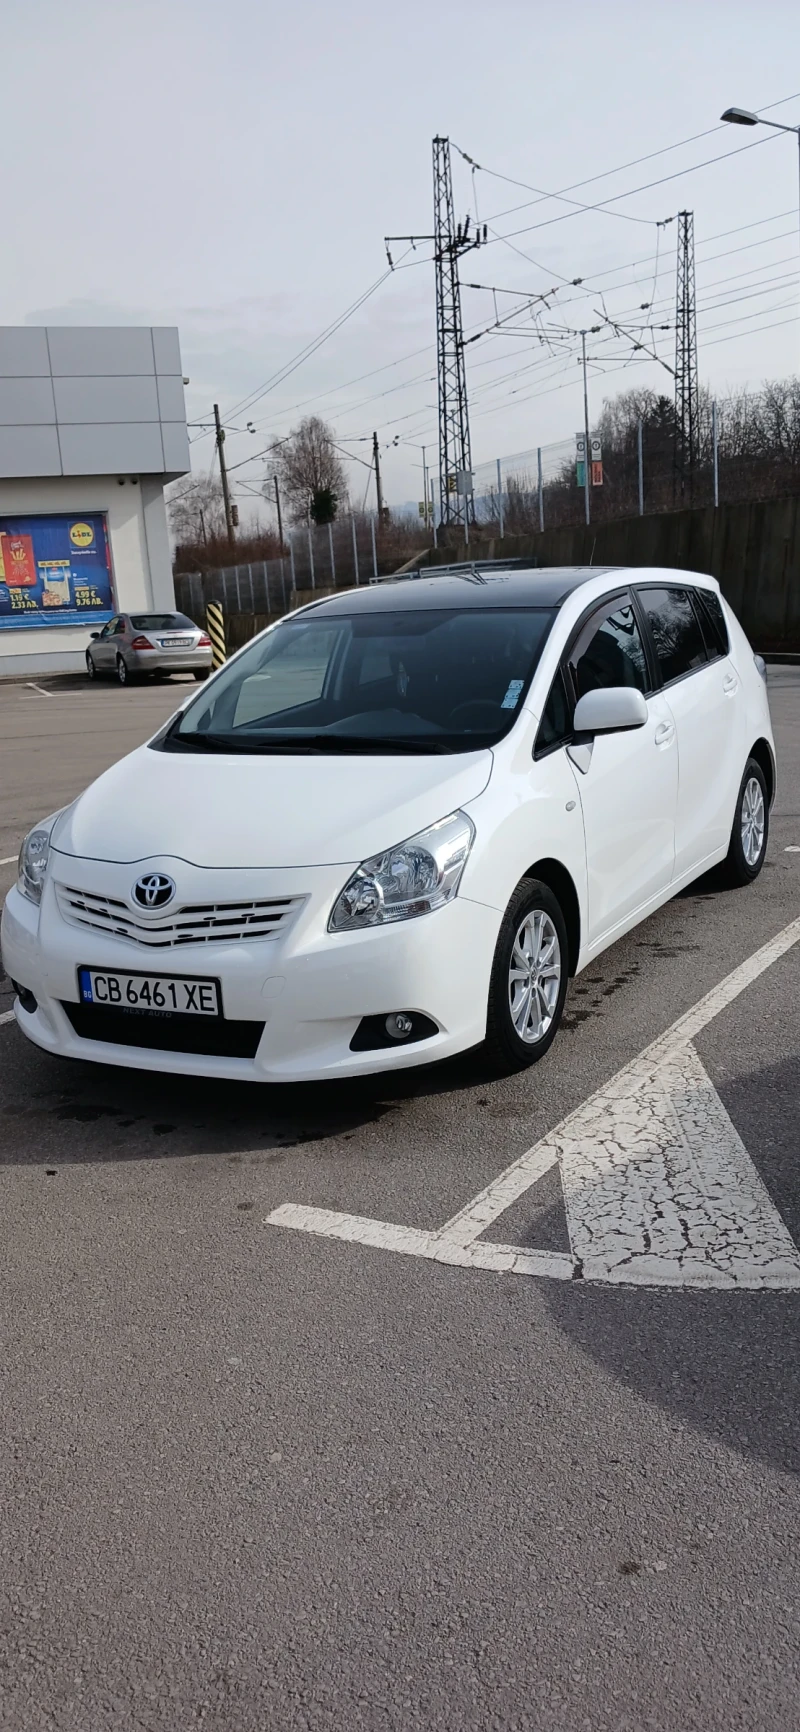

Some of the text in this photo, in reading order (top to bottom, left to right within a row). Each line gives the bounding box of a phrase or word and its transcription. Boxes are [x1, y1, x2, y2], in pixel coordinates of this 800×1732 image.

[72, 530, 92, 538] LIDL
[11, 601, 26, 609] 2.33
[76, 598, 91, 606] 9.76
[84, 990, 92, 998] BG
[94, 976, 214, 1012] CB 6461 XE
[123, 1008, 172, 1018] NEXT AUTO
